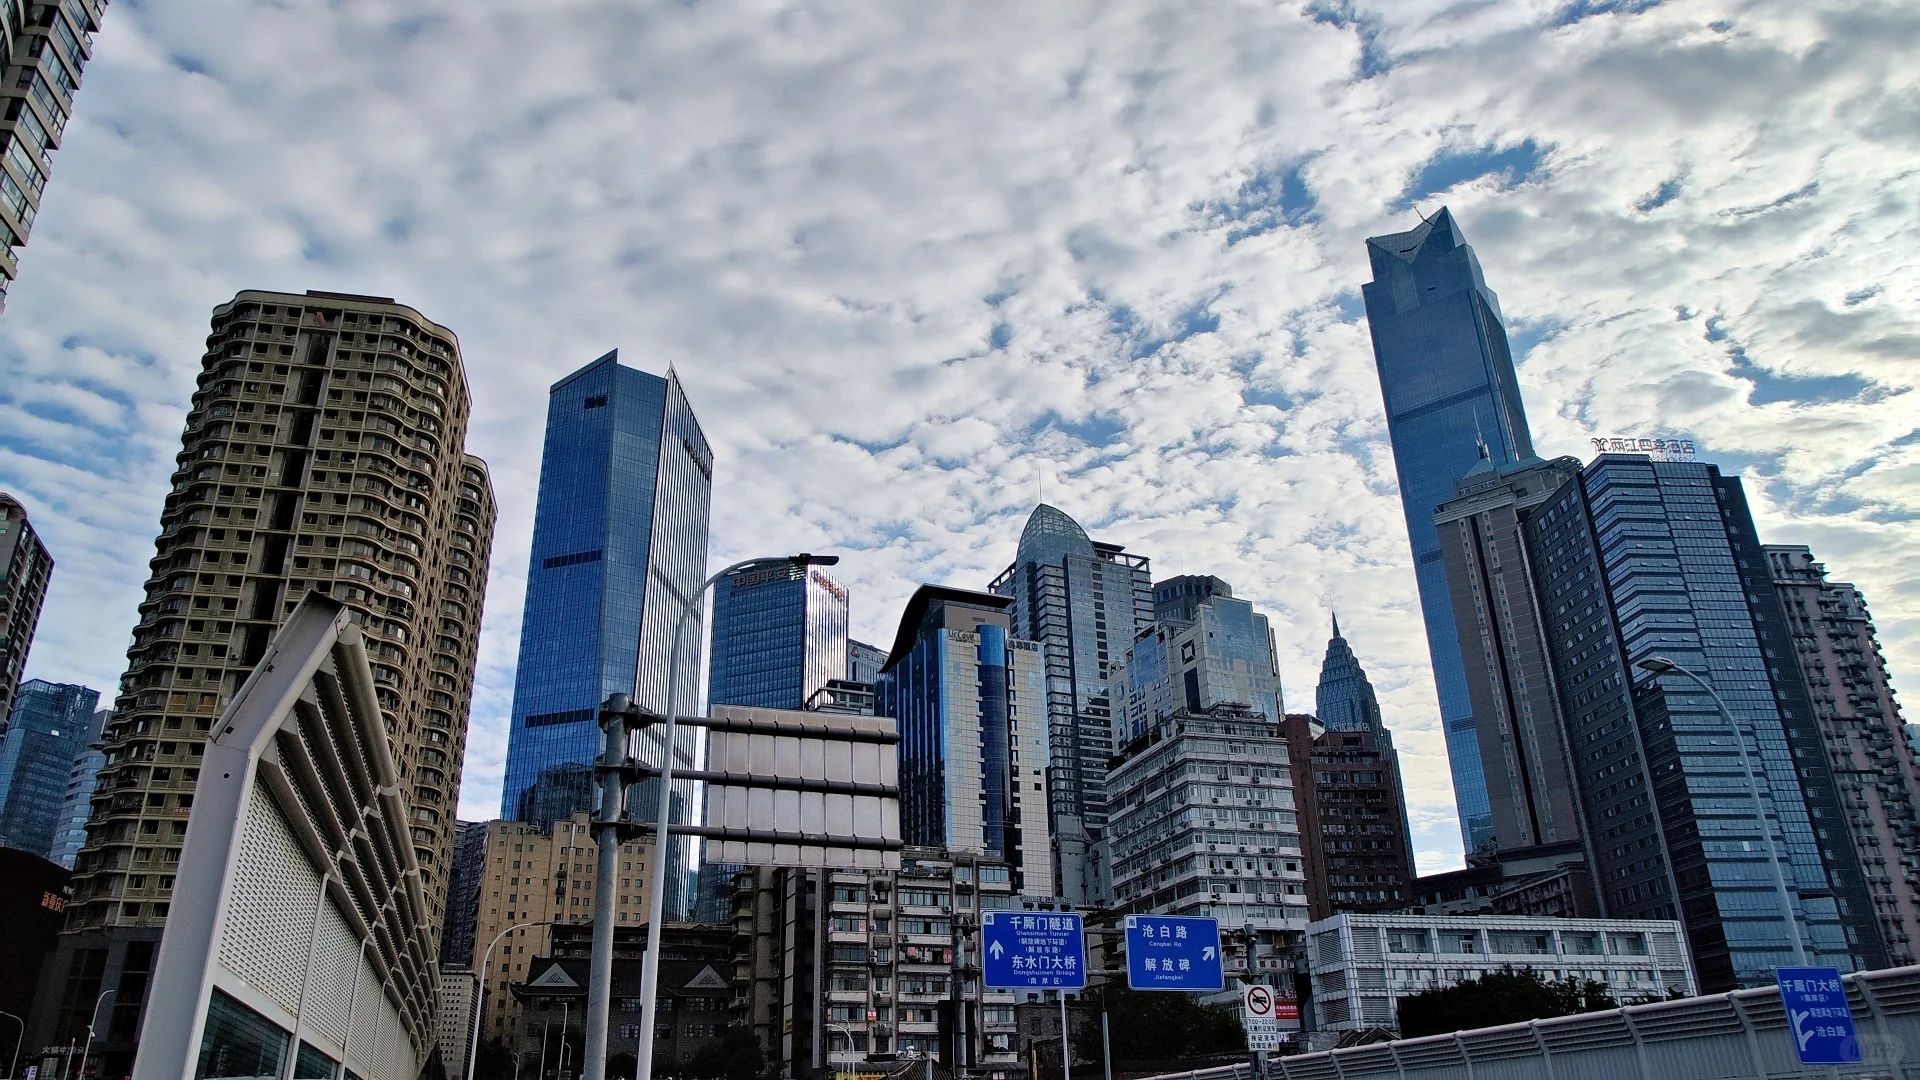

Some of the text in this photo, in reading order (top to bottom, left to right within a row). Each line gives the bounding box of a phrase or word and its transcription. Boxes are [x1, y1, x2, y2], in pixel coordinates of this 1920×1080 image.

[1609, 437, 1696, 454] 两江四季酒店
[732, 568, 788, 588] 中国平安
[1009, 916, 1074, 931] 千厮门隧道
[1142, 924, 1187, 939] 沧白路
[1149, 940, 1172, 948] Cangbai
[1012, 955, 1077, 970] 东水门大桥
[1144, 957, 1191, 972] 解放碑
[1013, 969, 1054, 977] Dongshuimen
[1782, 979, 1841, 993] 千厮门大桥
[1816, 1025, 1847, 1037] 沧白路
